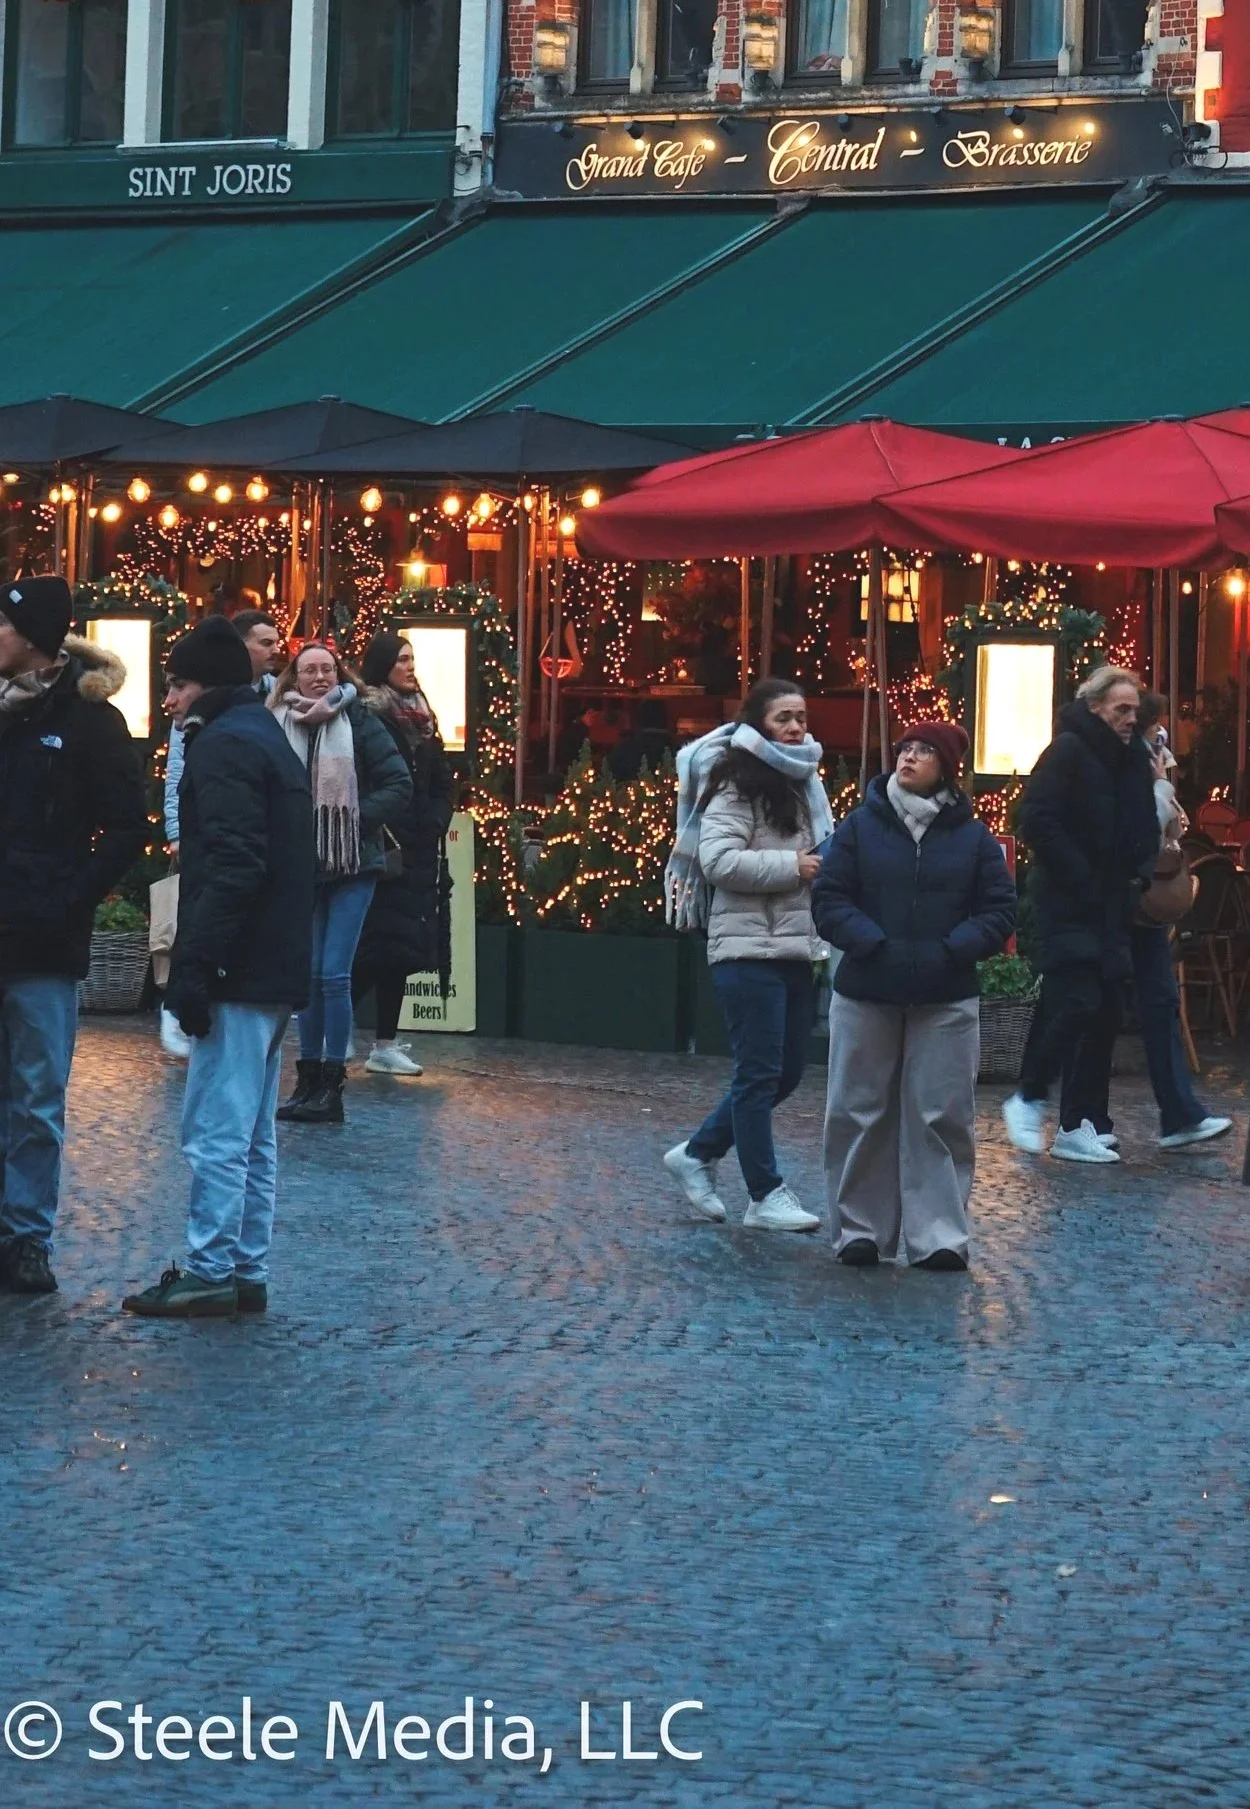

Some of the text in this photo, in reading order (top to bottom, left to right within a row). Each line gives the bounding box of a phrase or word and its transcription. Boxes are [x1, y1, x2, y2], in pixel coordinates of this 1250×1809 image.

[565, 143, 651, 191] Grand
[767, 119, 886, 185] Central
[942, 130, 1093, 168] Brasserie
[128, 163, 292, 198] SINT JORIS
[412, 1003, 442, 1020] Beers
